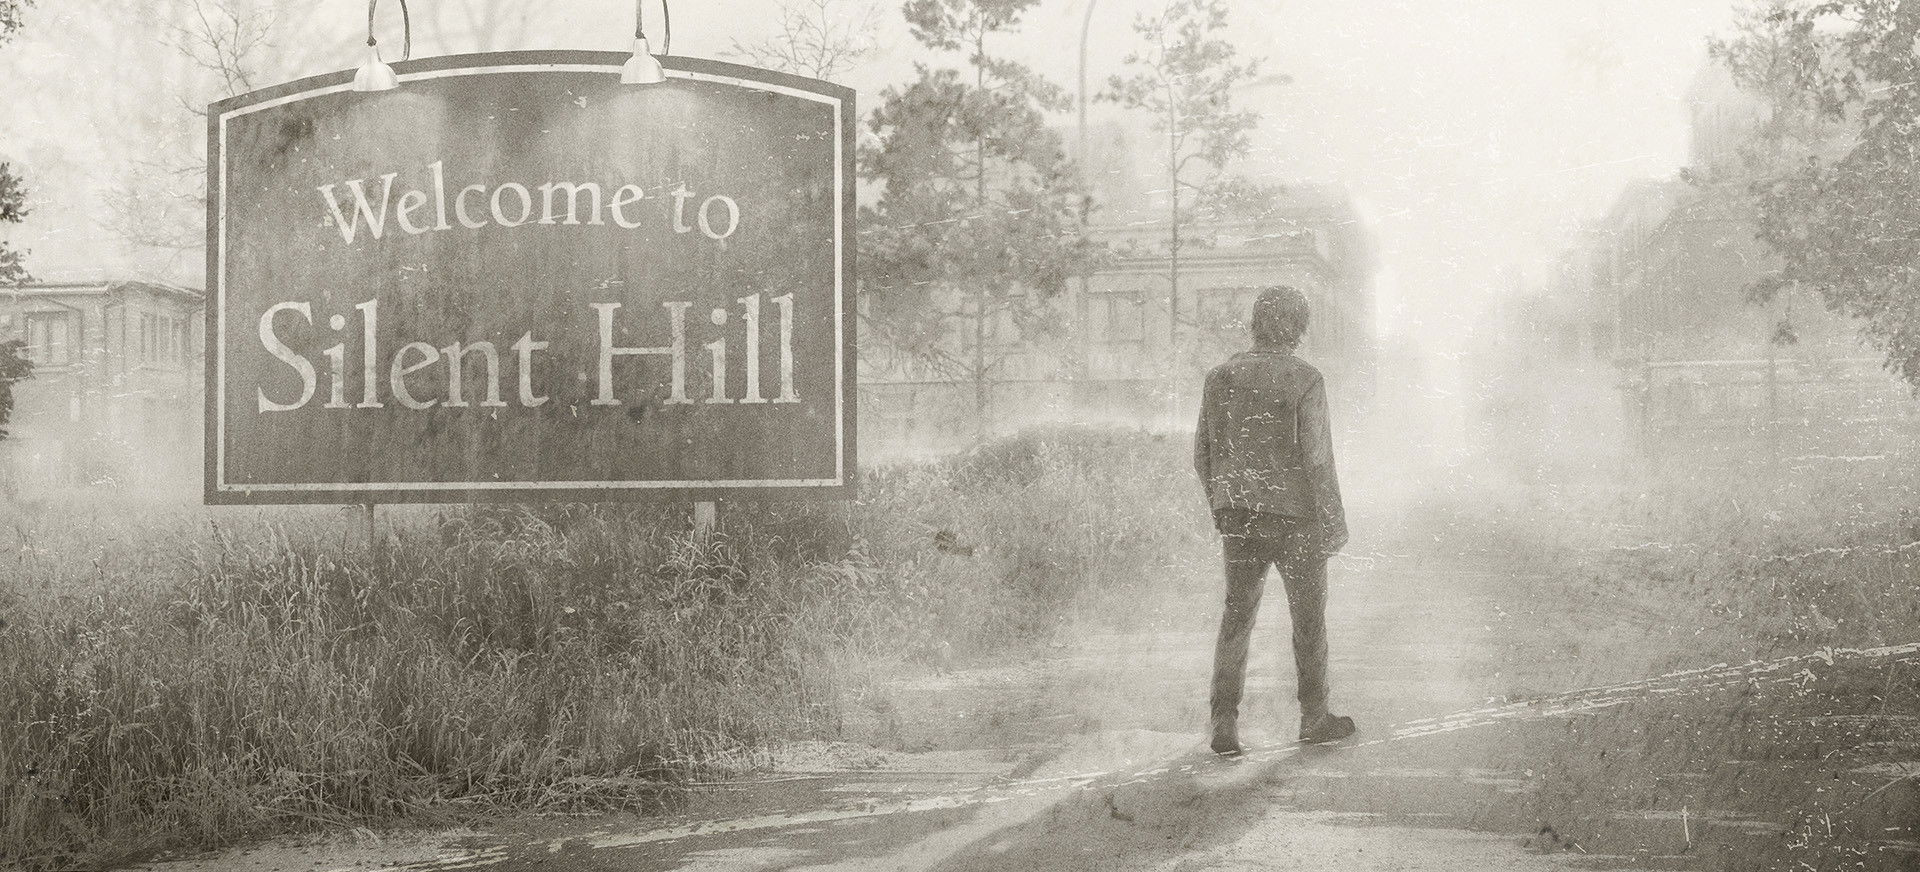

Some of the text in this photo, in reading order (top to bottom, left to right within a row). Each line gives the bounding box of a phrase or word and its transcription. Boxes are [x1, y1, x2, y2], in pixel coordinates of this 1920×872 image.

[317, 161, 740, 245] Welcome to
[257, 293, 802, 414] Silent Hill
